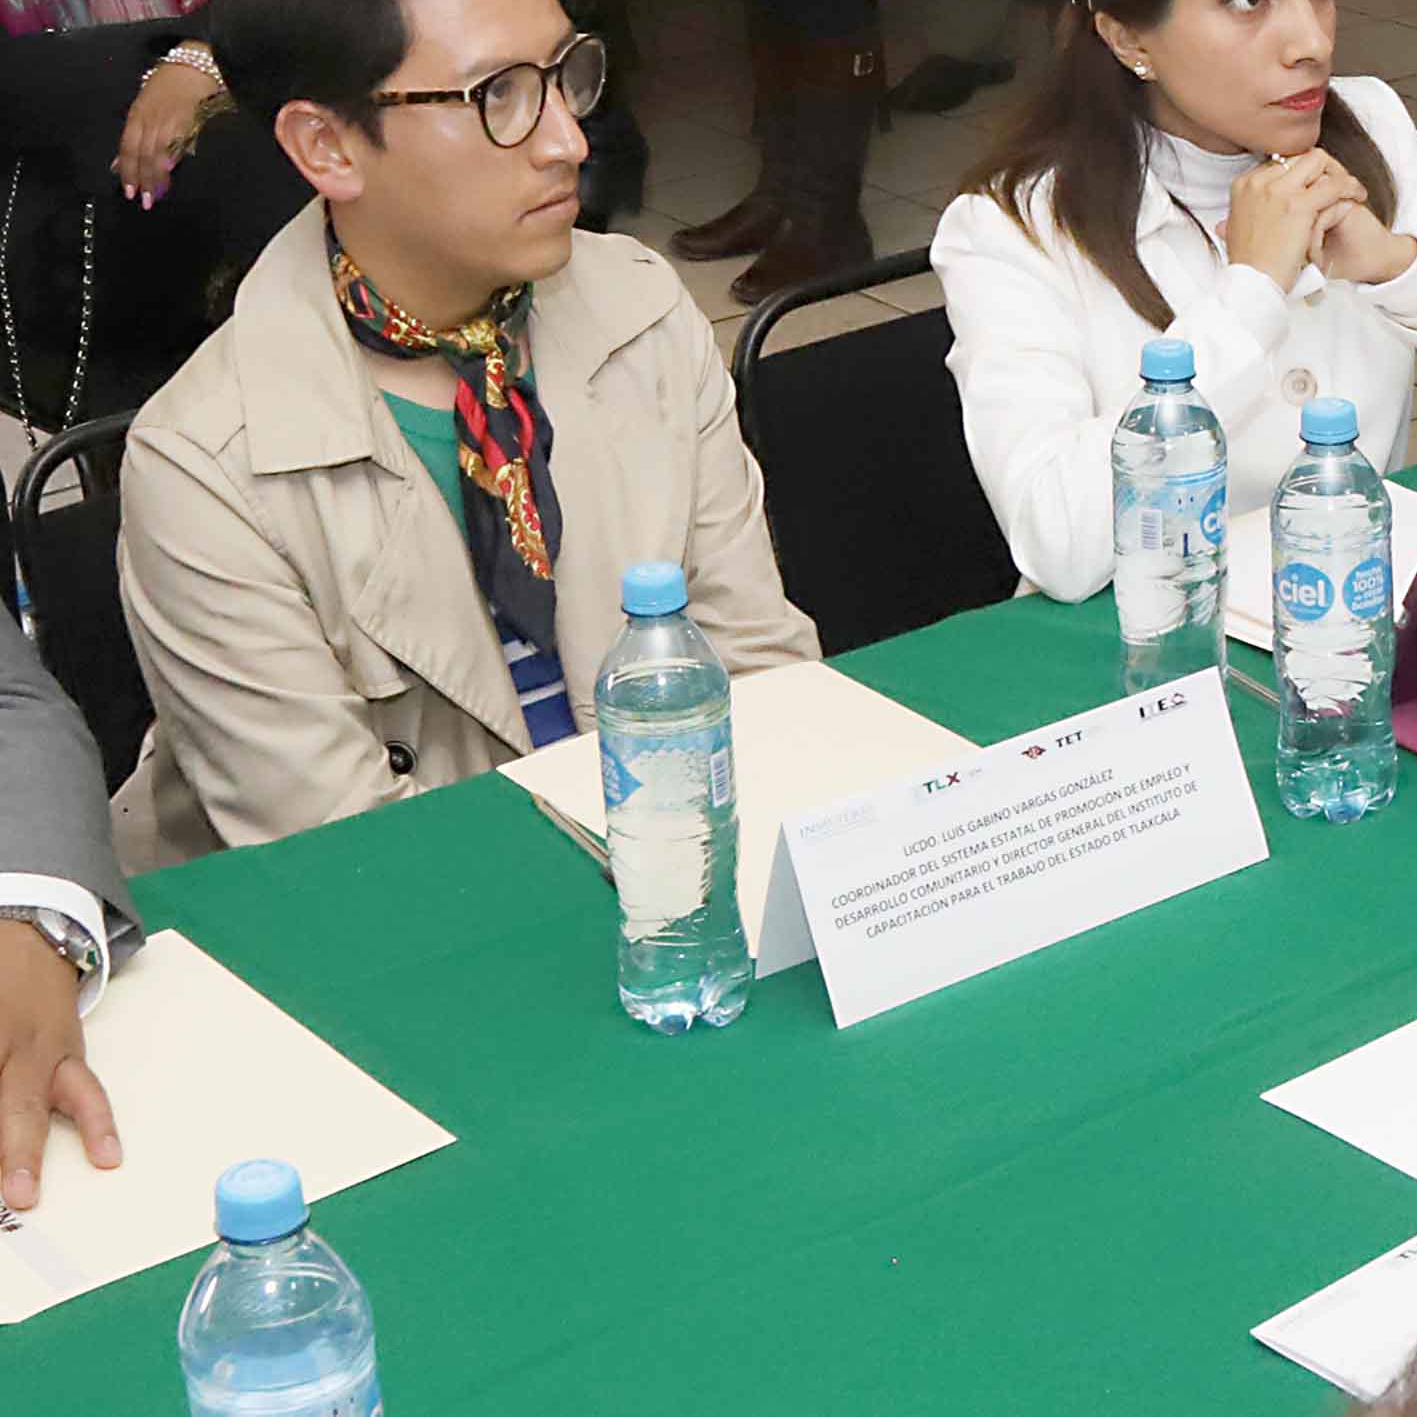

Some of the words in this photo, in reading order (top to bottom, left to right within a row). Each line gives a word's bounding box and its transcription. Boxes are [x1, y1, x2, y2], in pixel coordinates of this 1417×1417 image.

[1279, 573, 1327, 607] ciel
[1055, 731, 1084, 749] TET
[923, 772, 961, 794] TLX
[831, 867, 917, 910] COORDINADOR
[919, 861, 940, 877] DEL
[942, 841, 989, 868] SISTEMA
[991, 820, 1037, 849] ESTATAL
[1039, 815, 1053, 831] DE
[1124, 781, 1138, 798] DE
[1140, 765, 1182, 791] EMPLEO
[1182, 763, 1192, 775] Y
[942, 825, 966, 843] LUIS
[968, 808, 1012, 832] GABINO
[1013, 792, 1058, 815] VARGAS
[834, 892, 909, 930] DESARROLLO
[910, 860, 991, 901] COMUNITARIO
[993, 855, 1001, 869] Y
[1001, 836, 1055, 865] DIRECTOR
[1056, 817, 1106, 844] GENERAL
[1106, 810, 1128, 825] DEL
[1128, 786, 1183, 817] INSTITUTO
[1184, 780, 1200, 796] DE
[950, 883, 982, 907] PARA
[982, 879, 996, 894] EL
[996, 858, 1046, 887] TRABAJO
[1047, 853, 1068, 869] DEL
[1068, 834, 1112, 861] ESTADO
[1112, 829, 1129, 844] DE
[1129, 808, 1181, 836] TLAXCALA
